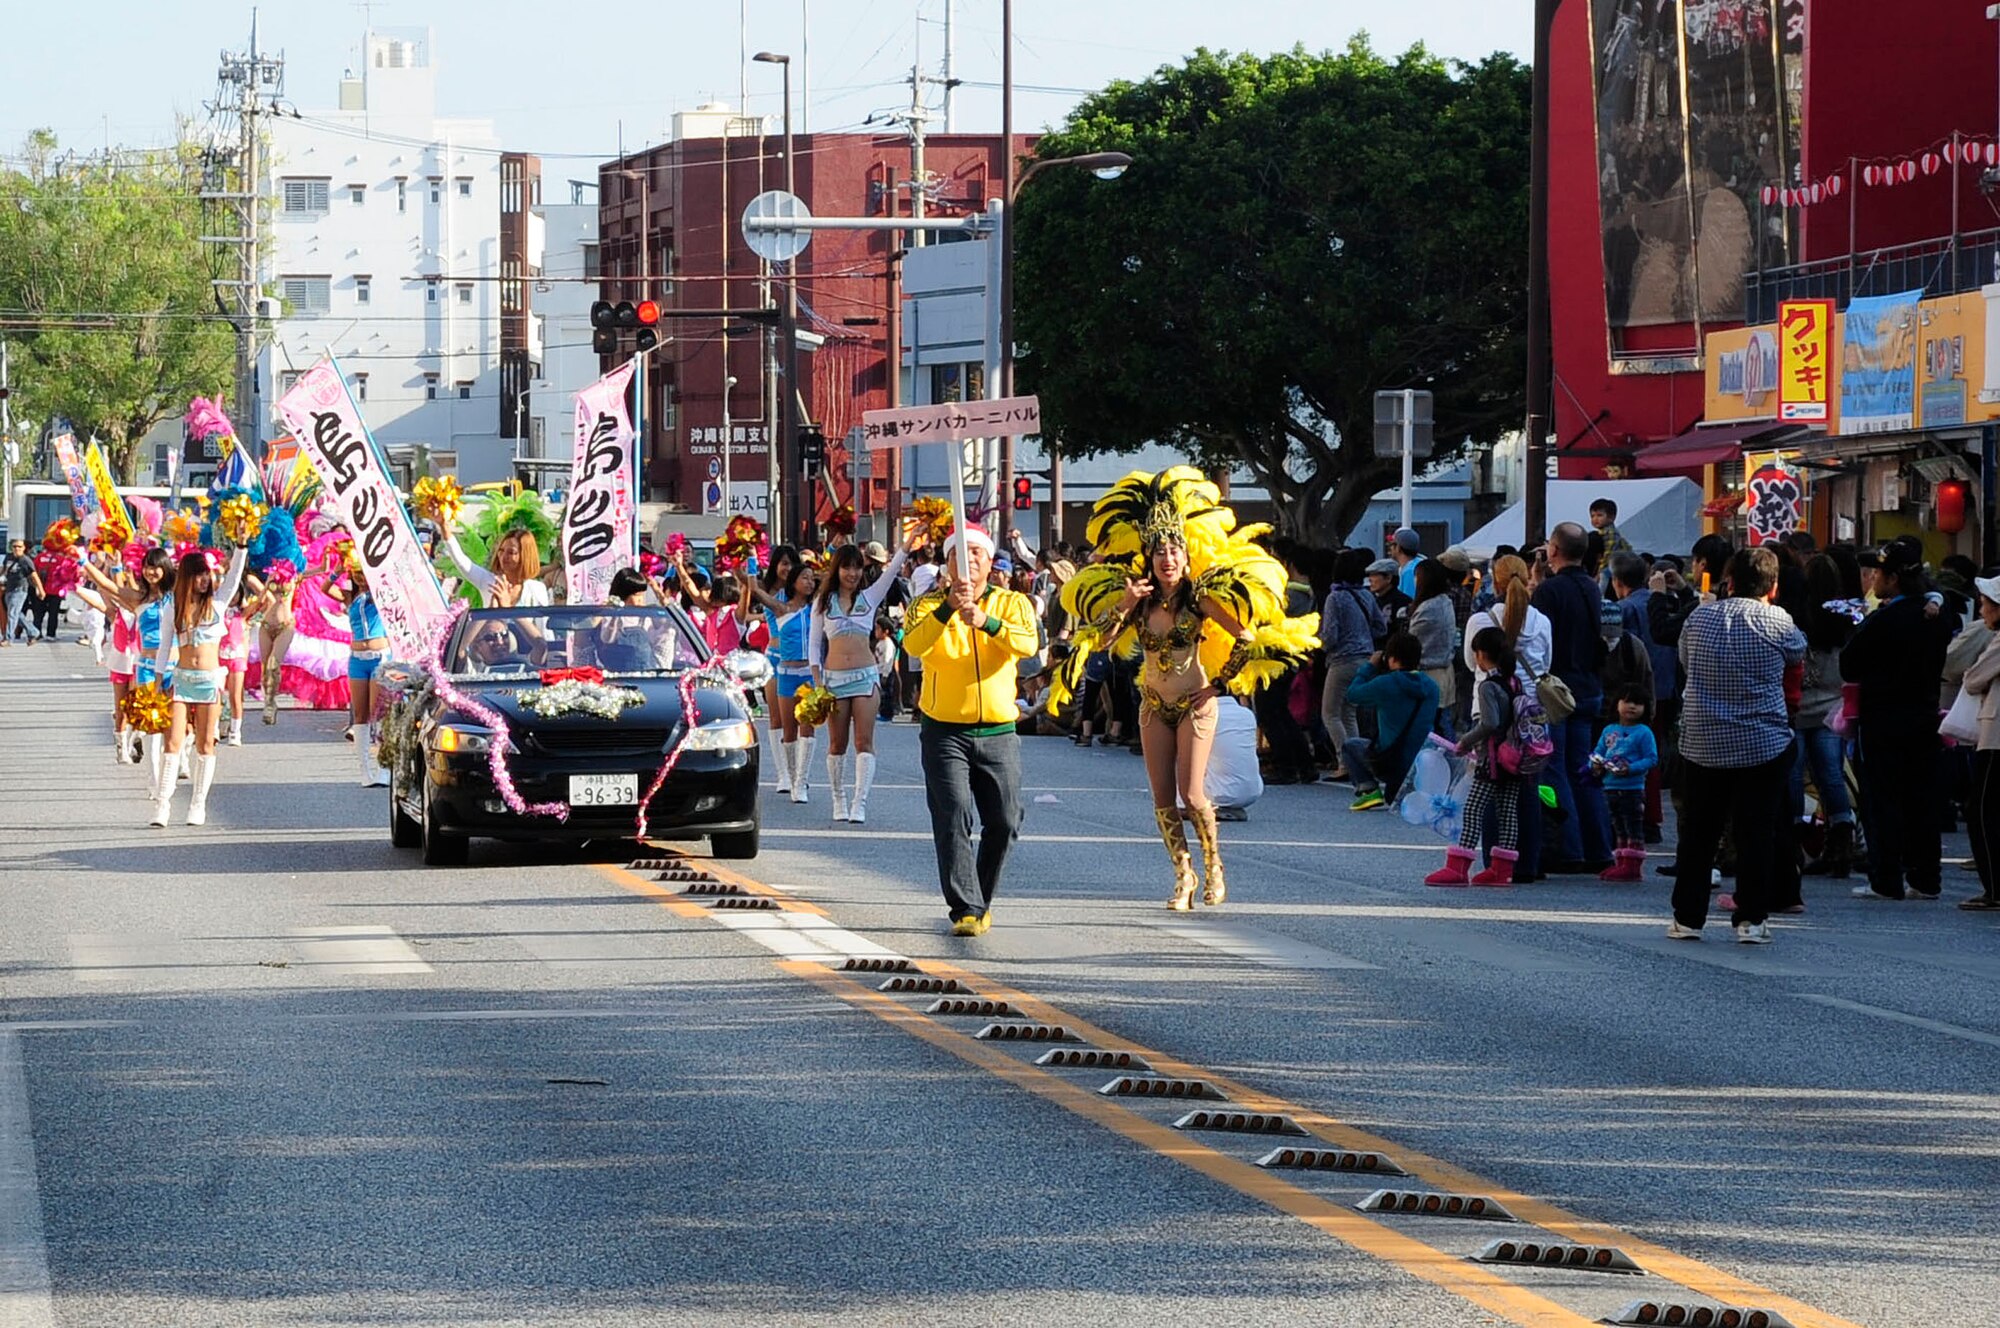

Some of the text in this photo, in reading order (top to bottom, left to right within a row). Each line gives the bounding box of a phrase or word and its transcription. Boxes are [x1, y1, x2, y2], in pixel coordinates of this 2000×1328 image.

[1783, 308, 1822, 402] クッキー
[864, 406, 1038, 440] 沖縄サンバカーニバル
[729, 494, 768, 511] 出入口
[584, 786, 633, 804] 96-39
